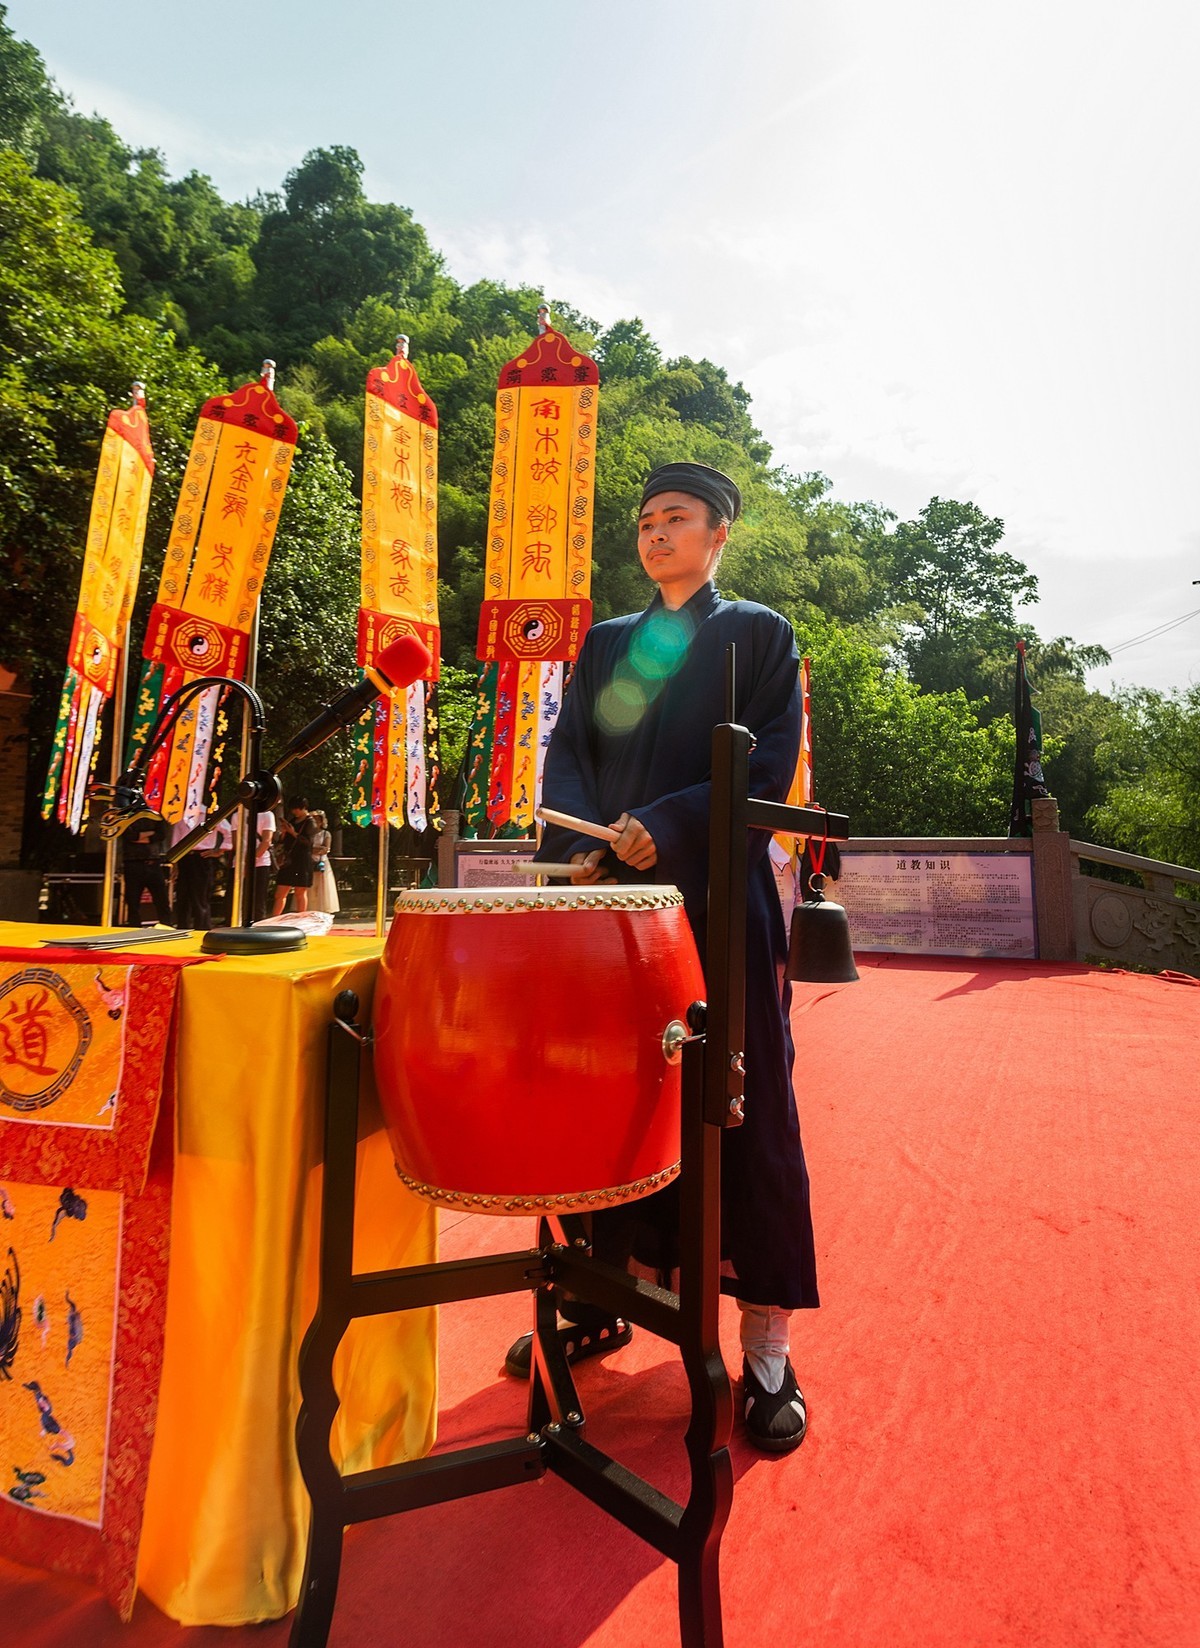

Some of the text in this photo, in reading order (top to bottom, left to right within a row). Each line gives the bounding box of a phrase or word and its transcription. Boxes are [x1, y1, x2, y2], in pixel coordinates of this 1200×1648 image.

[896, 859, 951, 870] 道教知识
[0, 989, 59, 1076] 道
